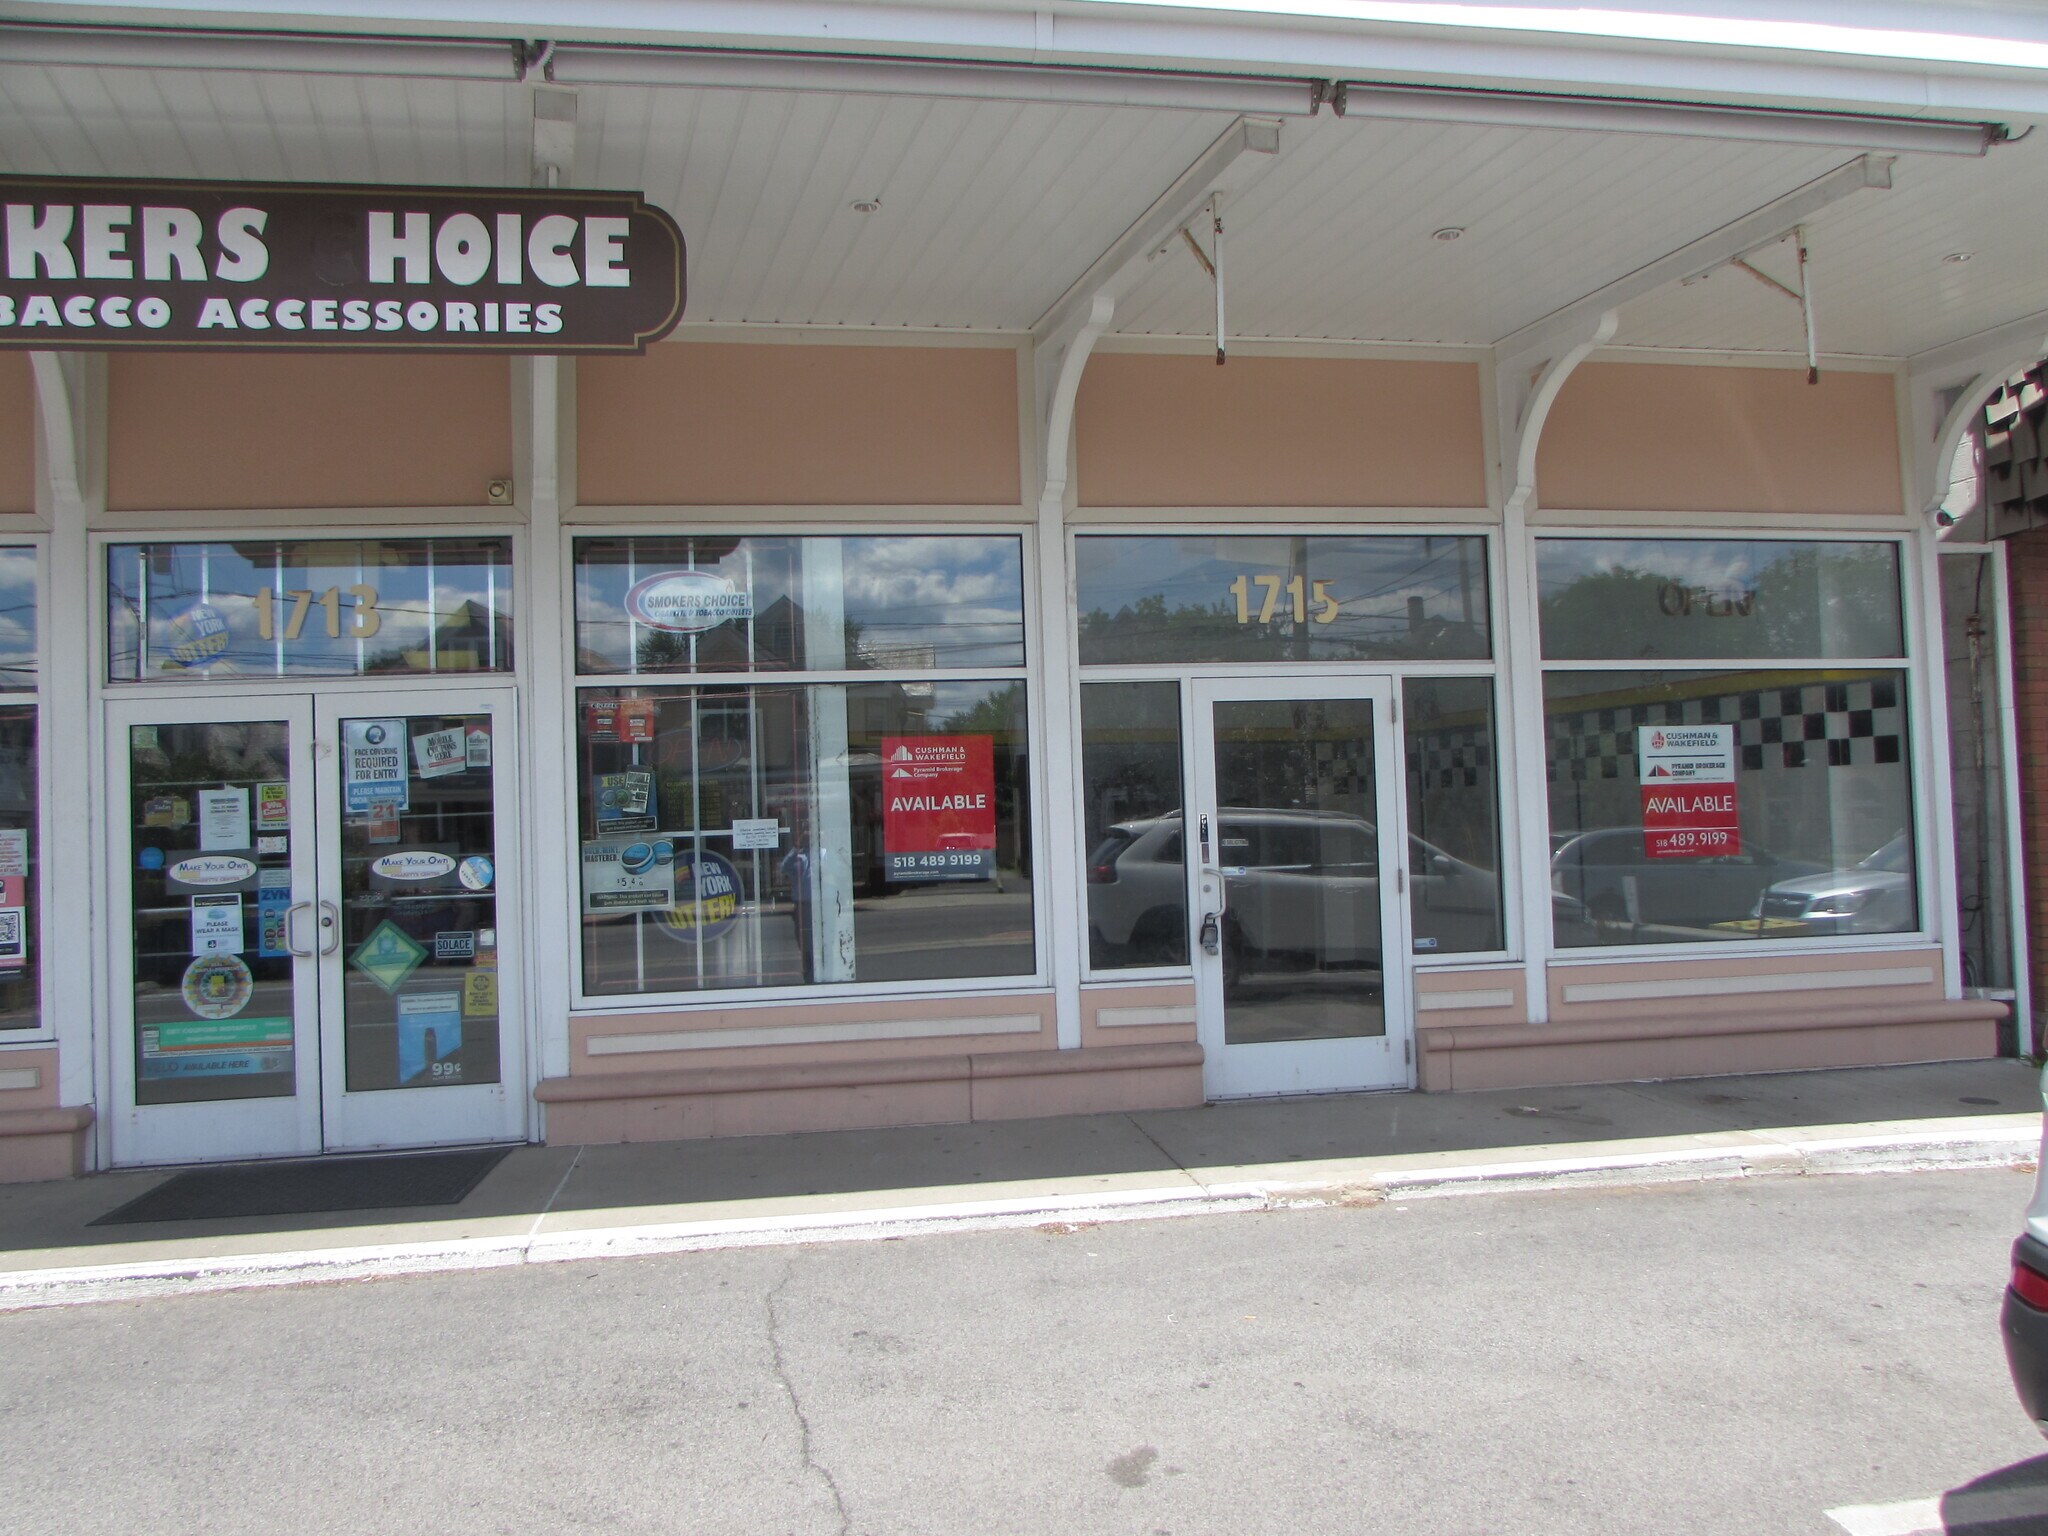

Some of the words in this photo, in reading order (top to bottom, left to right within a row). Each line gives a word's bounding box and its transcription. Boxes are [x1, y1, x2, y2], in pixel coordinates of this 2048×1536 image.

[6, 204, 270, 283] KERS
[197, 298, 563, 333] ACCESSORIES
[647, 595, 701, 608] SMOKERS
[1229, 575, 1339, 624] 1715
[190, 608, 216, 621] NEW
[252, 584, 381, 640] 1713
[196, 618, 227, 637] YORK
[1665, 732, 1711, 740] CUSHMAN
[1666, 739, 1717, 747] WAKEFIELD
[370, 747, 398, 755] COVERING
[915, 753, 966, 761] WAKEFIELD
[355, 756, 398, 769] REQUIRED
[355, 769, 371, 780] FOR
[373, 768, 398, 780] ENTRY
[608, 776, 624, 786] USE
[353, 786, 374, 795] PLEASE
[375, 785, 402, 794] MAINTAIN
[890, 794, 986, 812] AVAILABLE
[1645, 795, 1733, 814] AVAILABLE
[372, 803, 396, 818] 21
[1656, 839, 1668, 847] 518
[1669, 831, 1728, 847] 489.9199
[381, 858, 403, 866] MAKE
[405, 857, 426, 865] YOUR
[584, 854, 619, 862] MASTERED.
[893, 856, 916, 868] 518
[920, 855, 946, 867] 489
[949, 854, 981, 865] 9199
[179, 863, 202, 871] MAKE
[204, 861, 225, 870] YOUR
[692, 861, 722, 876] NEW
[699, 875, 732, 897] YORK
[262, 889, 290, 900] ZYN
[664, 893, 736, 930] LOTTERY
[437, 939, 470, 950] SOLACE
[183, 1060, 228, 1071] AVAILABLE
[229, 1059, 250, 1069] HERE
[432, 1062, 462, 1076] 99¢
